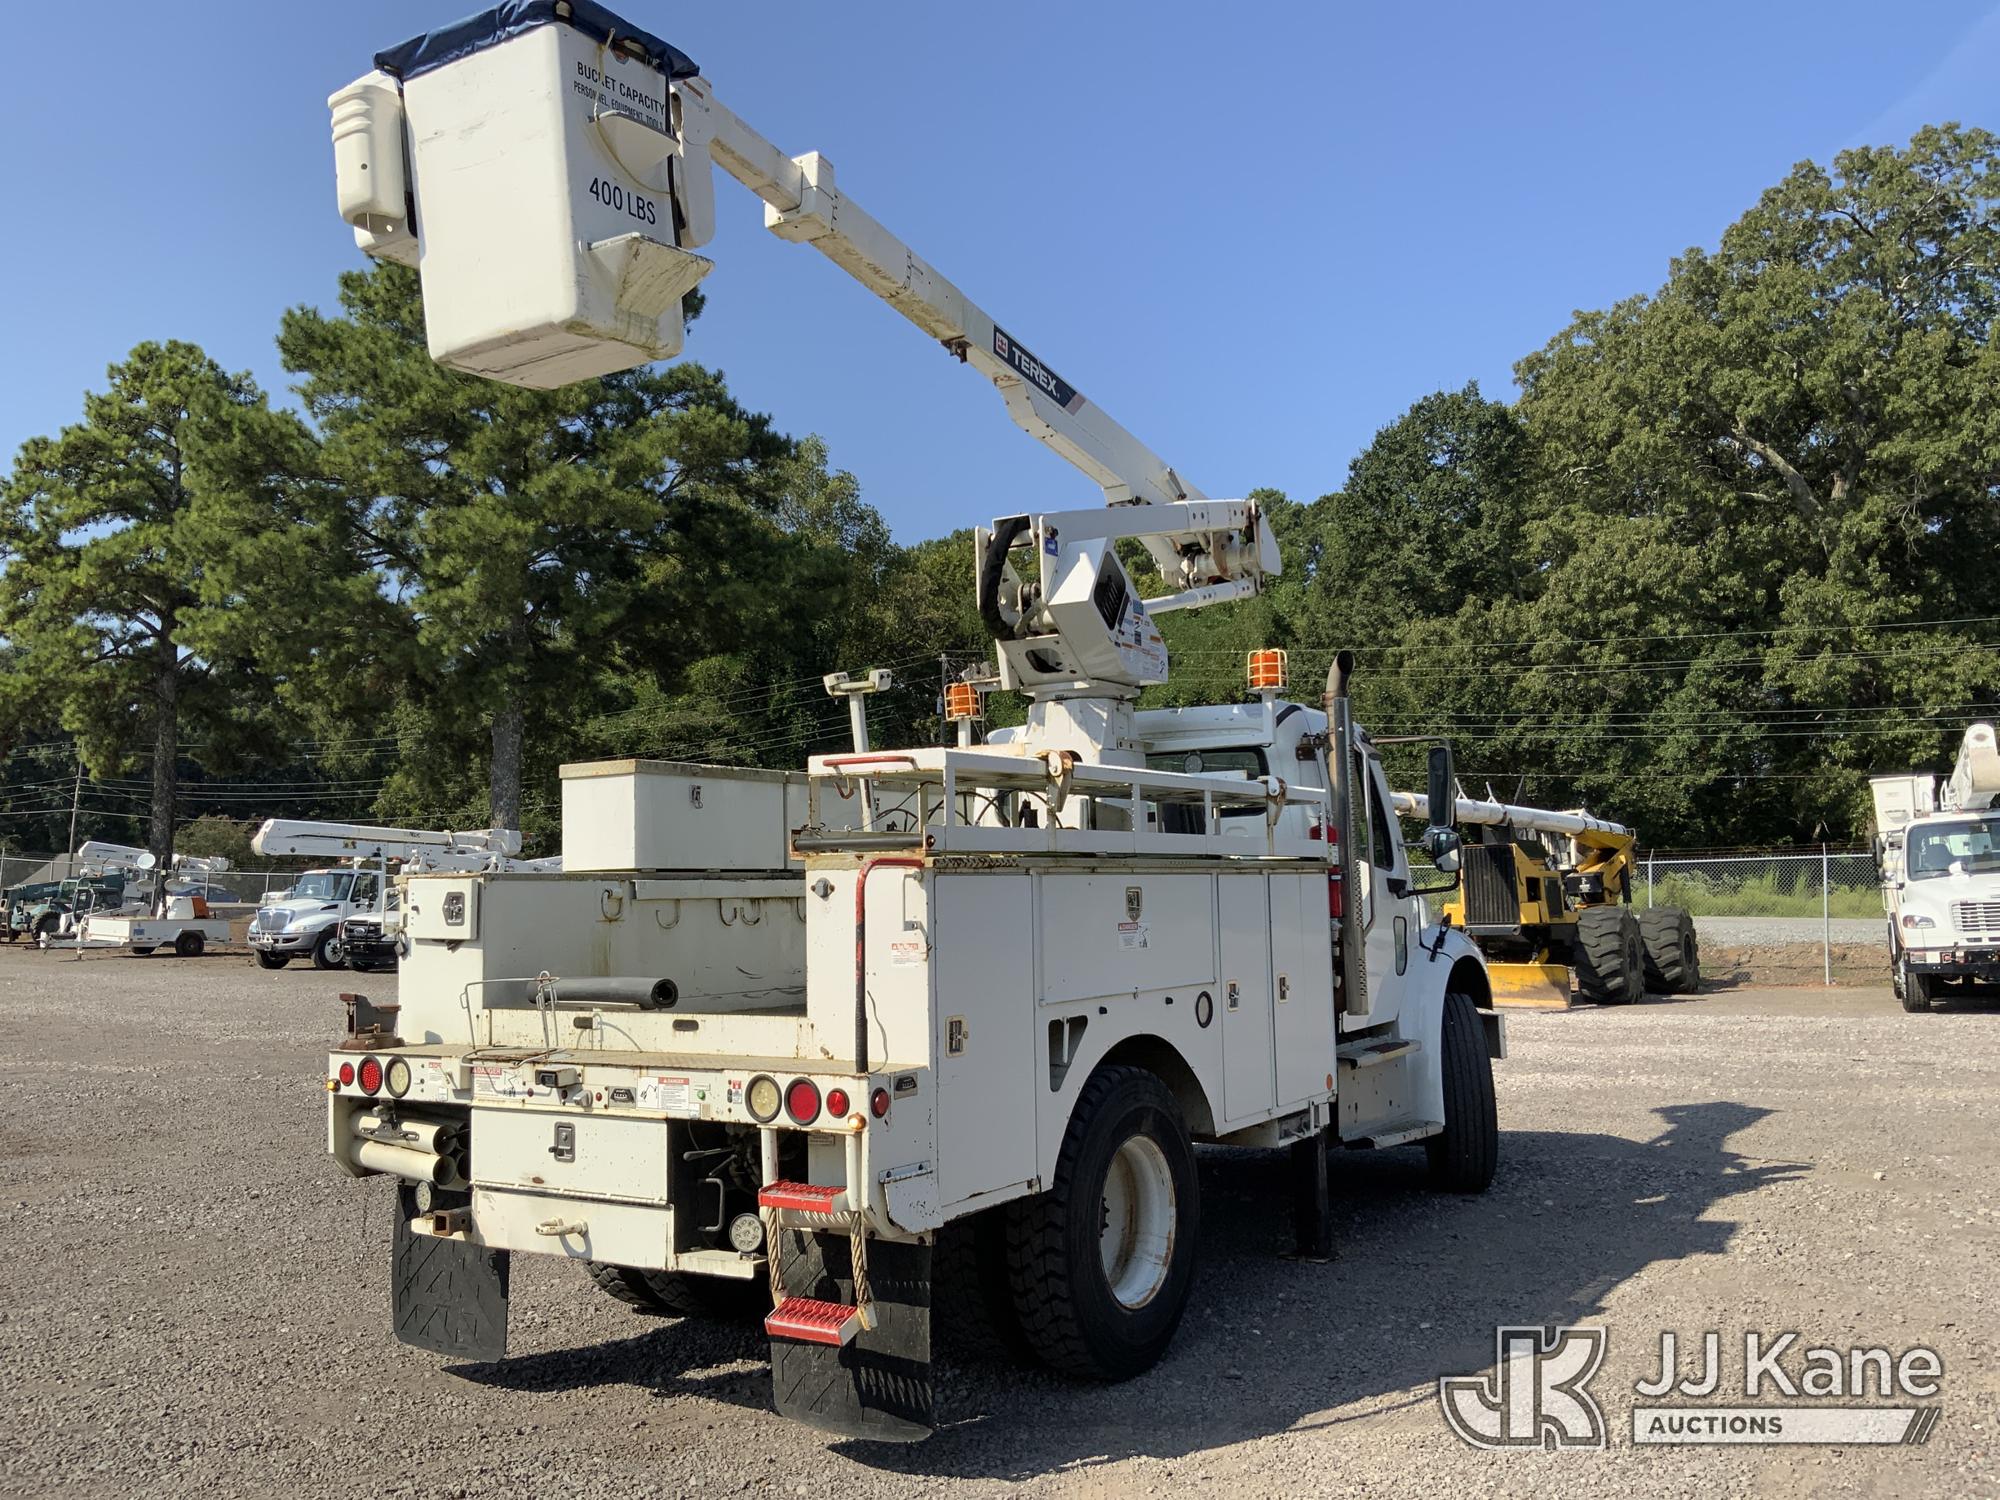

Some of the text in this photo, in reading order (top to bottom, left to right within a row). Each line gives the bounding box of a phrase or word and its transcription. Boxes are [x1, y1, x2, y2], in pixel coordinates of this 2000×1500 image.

[619, 82, 665, 116] CAPACITY
[589, 177, 656, 225] 400 LBS
[1011, 346, 1058, 397] TEREX
